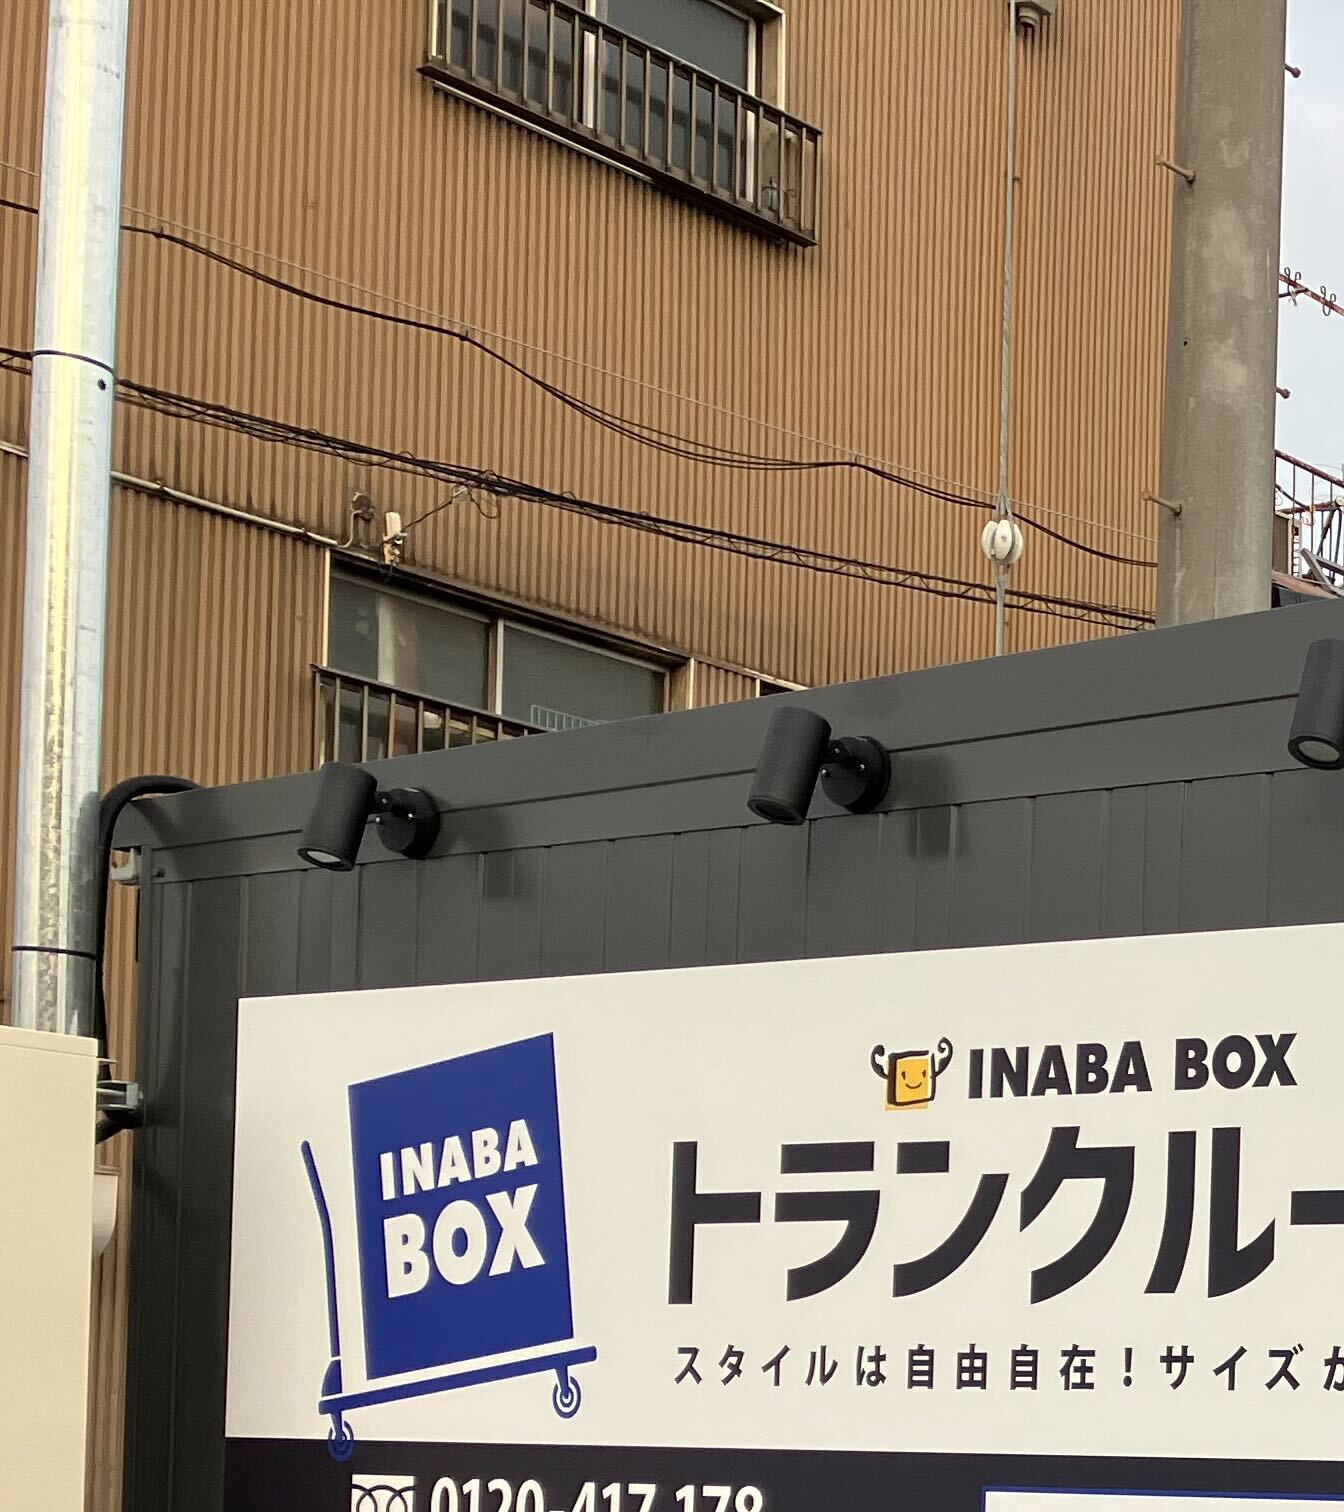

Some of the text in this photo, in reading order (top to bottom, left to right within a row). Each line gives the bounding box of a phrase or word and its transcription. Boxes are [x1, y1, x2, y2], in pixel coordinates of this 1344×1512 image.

[968, 1033, 1298, 1099] INABA BOX
[379, 1119, 539, 1201] INABA
[383, 1183, 546, 1299] BOX
